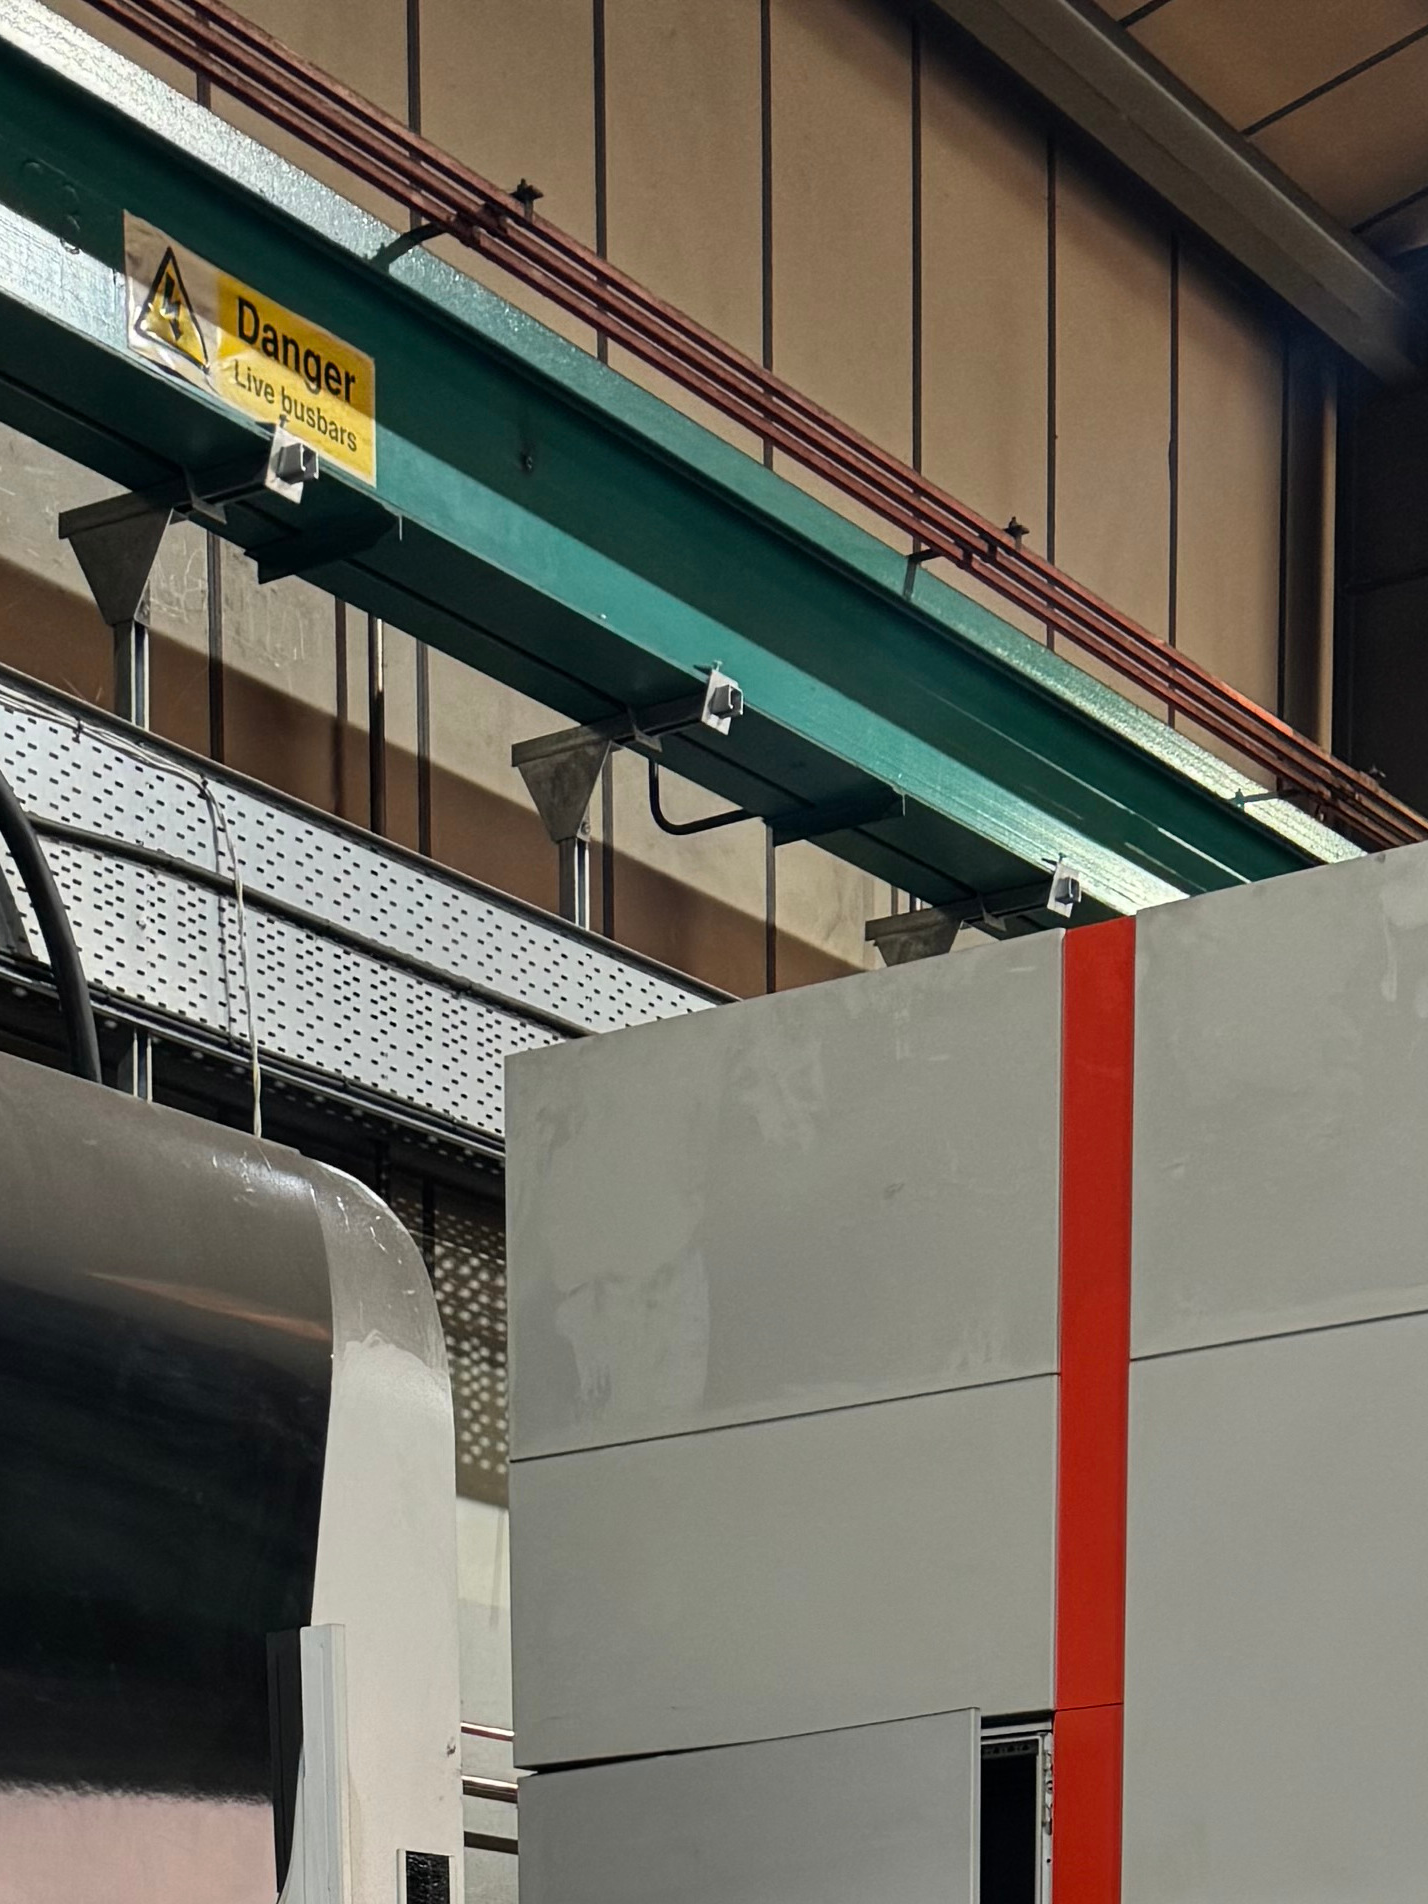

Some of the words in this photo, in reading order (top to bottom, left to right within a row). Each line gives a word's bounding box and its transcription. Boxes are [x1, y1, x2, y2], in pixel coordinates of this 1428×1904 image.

[236, 295, 356, 403] Danger
[233, 359, 275, 404] Live
[281, 388, 358, 452] busbars
